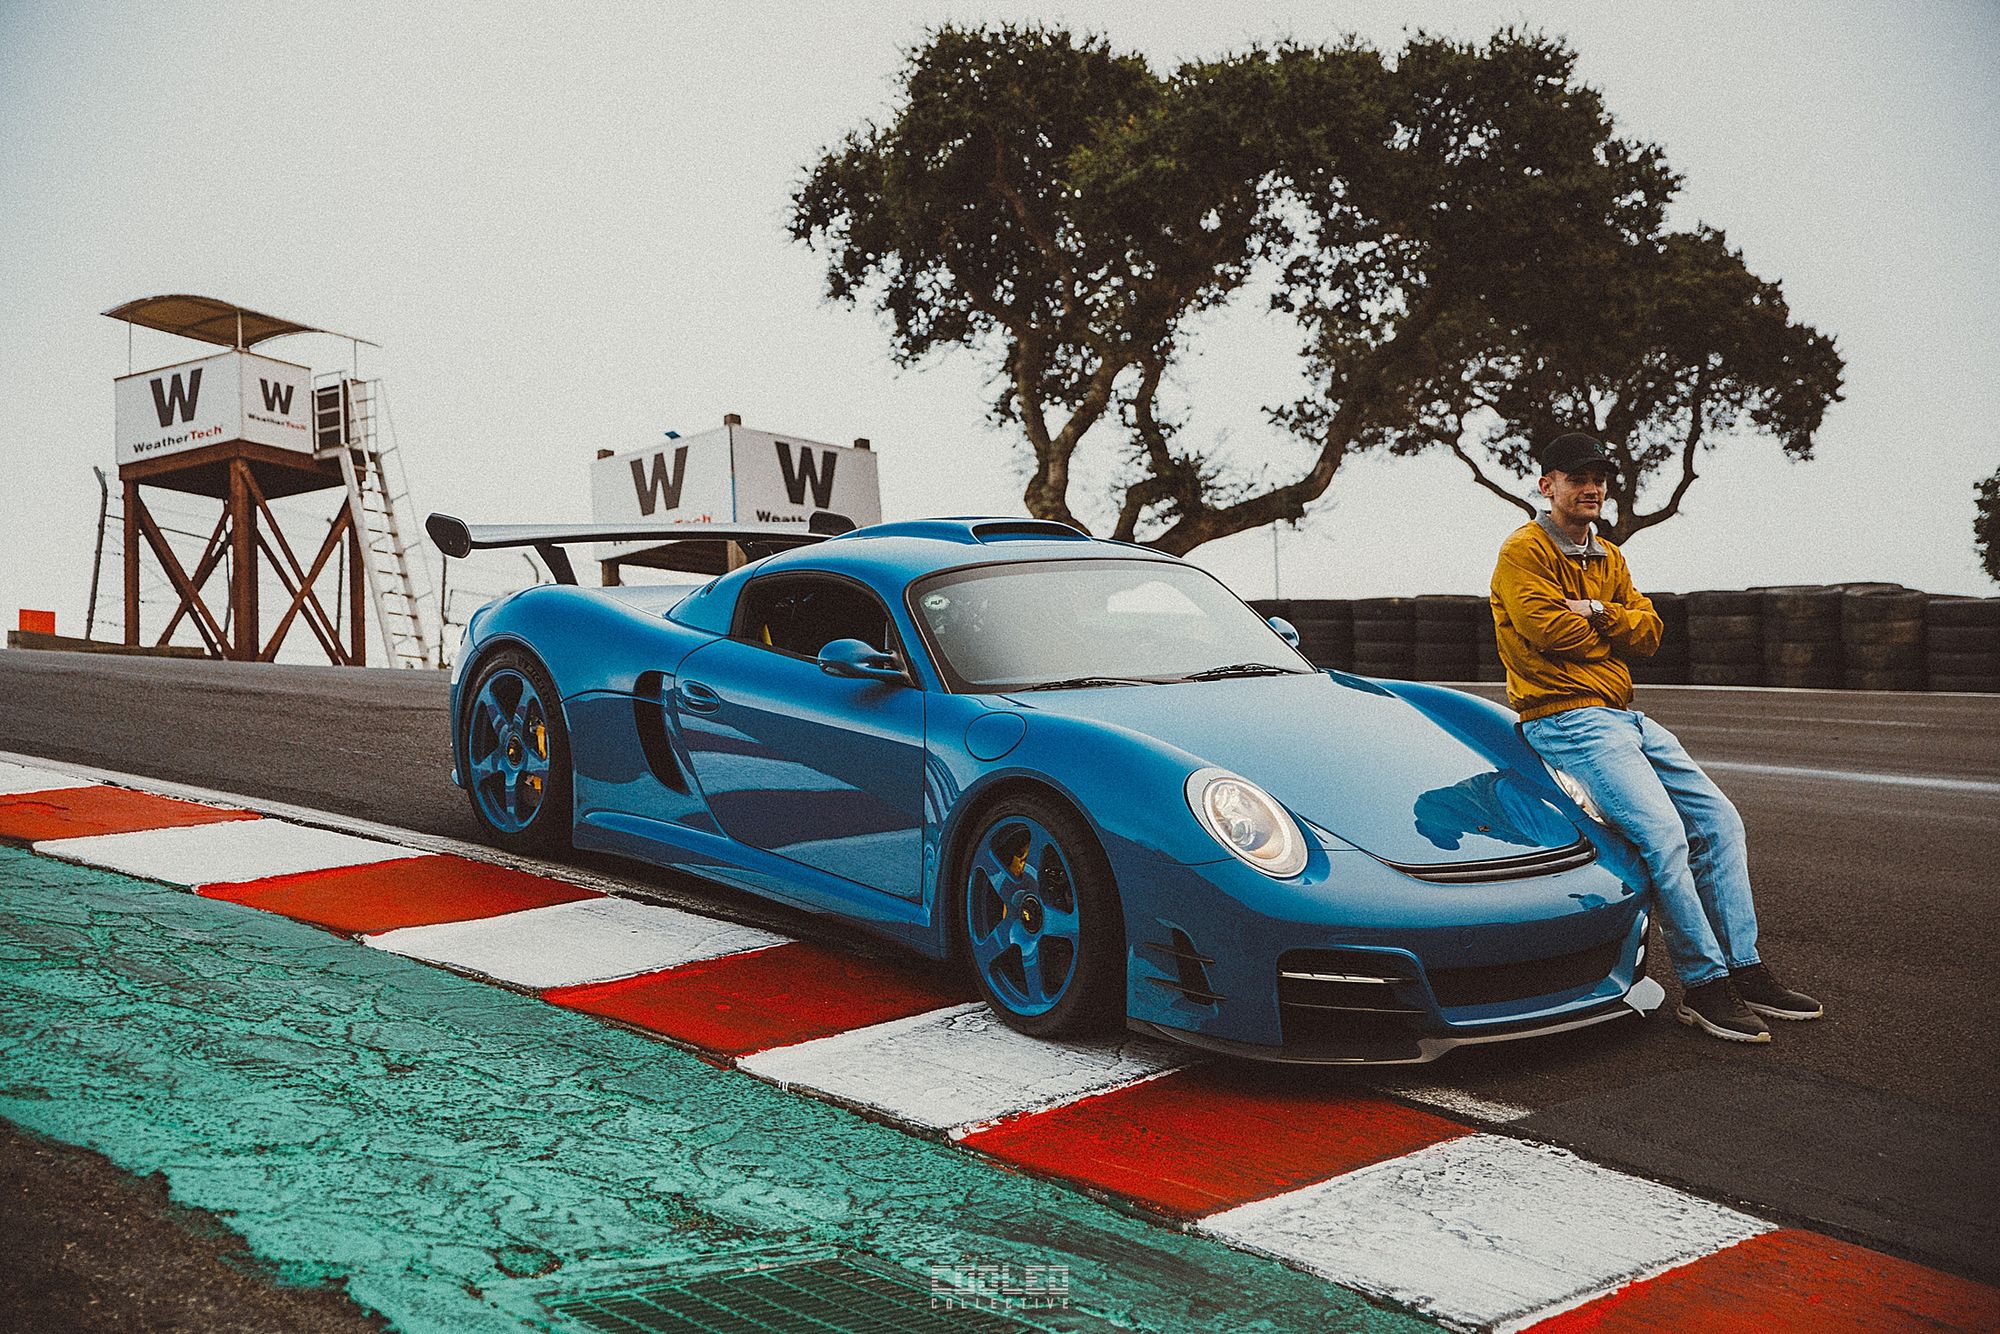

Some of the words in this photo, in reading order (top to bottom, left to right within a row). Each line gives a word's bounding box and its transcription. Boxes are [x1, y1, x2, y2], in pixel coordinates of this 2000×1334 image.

[149, 367, 203, 428] W
[259, 378, 295, 416] W
[133, 425, 223, 453] WeatherTech
[629, 445, 689, 517] W
[774, 440, 838, 510] W
